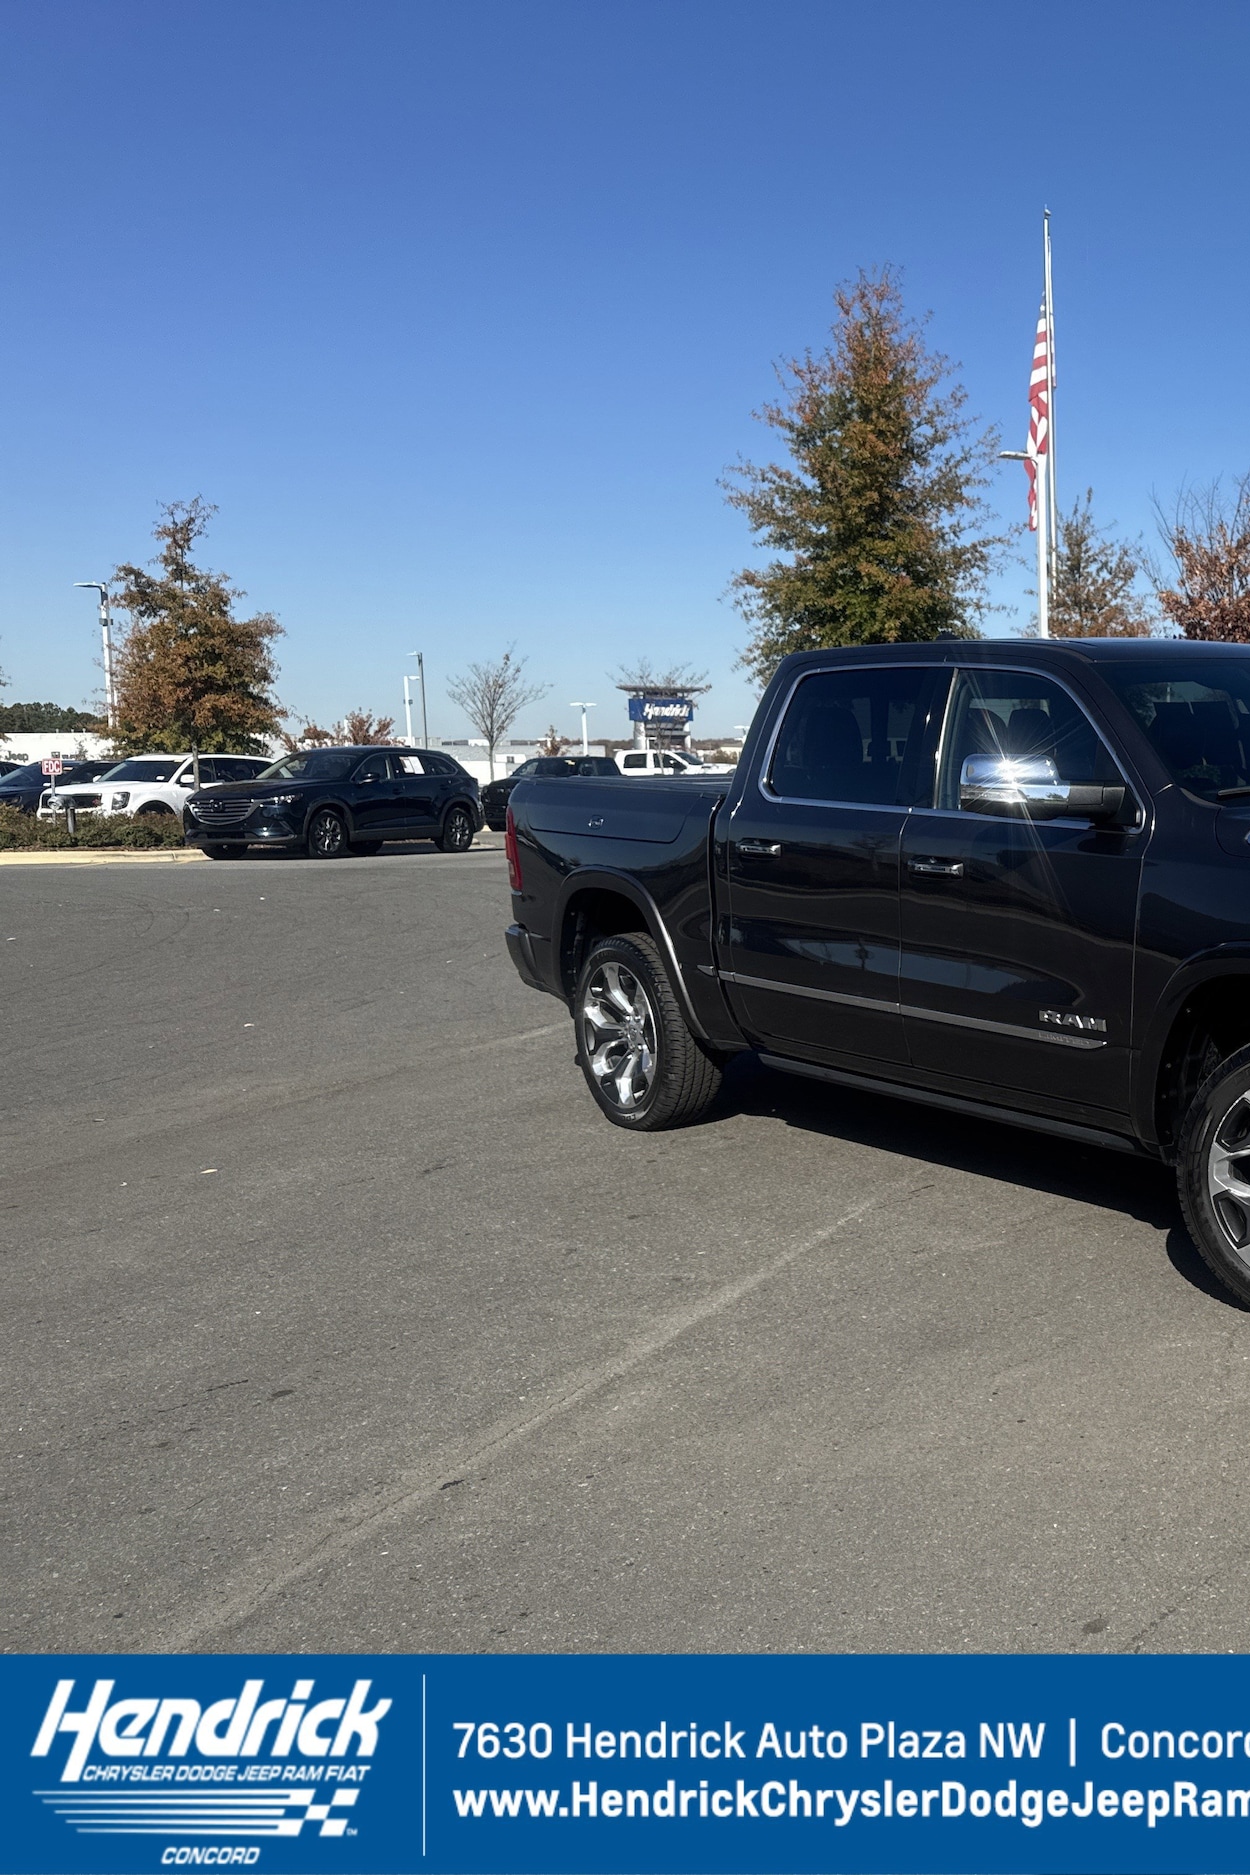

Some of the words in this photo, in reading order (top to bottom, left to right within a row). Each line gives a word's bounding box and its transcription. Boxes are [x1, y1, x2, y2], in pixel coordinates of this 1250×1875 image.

[643, 703, 690, 720] Hendrick
[5, 750, 28, 763] Jeep
[44, 760, 60, 773] FDC
[1038, 1010, 1107, 1032] RAM
[1038, 1031, 1090, 1046] LIMITED
